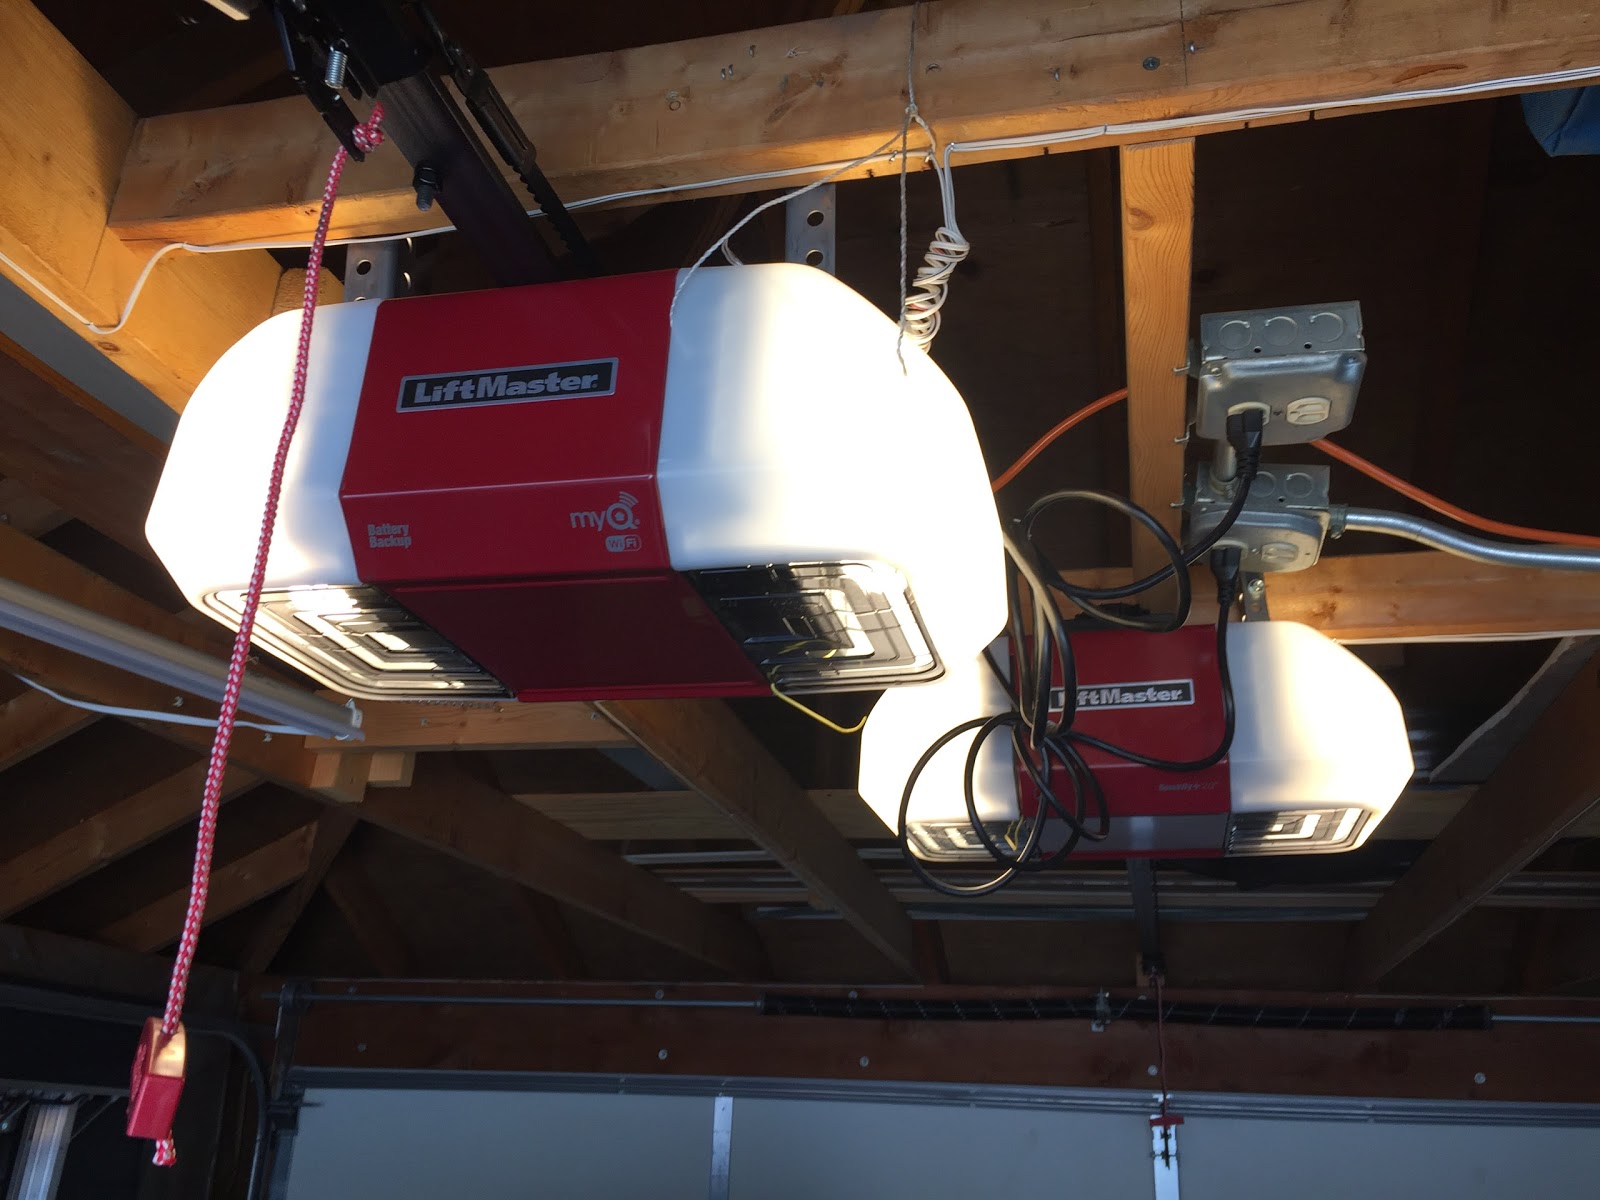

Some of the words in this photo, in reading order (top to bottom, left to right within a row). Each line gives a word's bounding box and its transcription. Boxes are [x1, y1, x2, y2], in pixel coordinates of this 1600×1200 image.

[413, 372, 599, 404] LiftMaster
[569, 502, 639, 532] myQ
[367, 523, 409, 536] Battery
[369, 535, 412, 549] Backup
